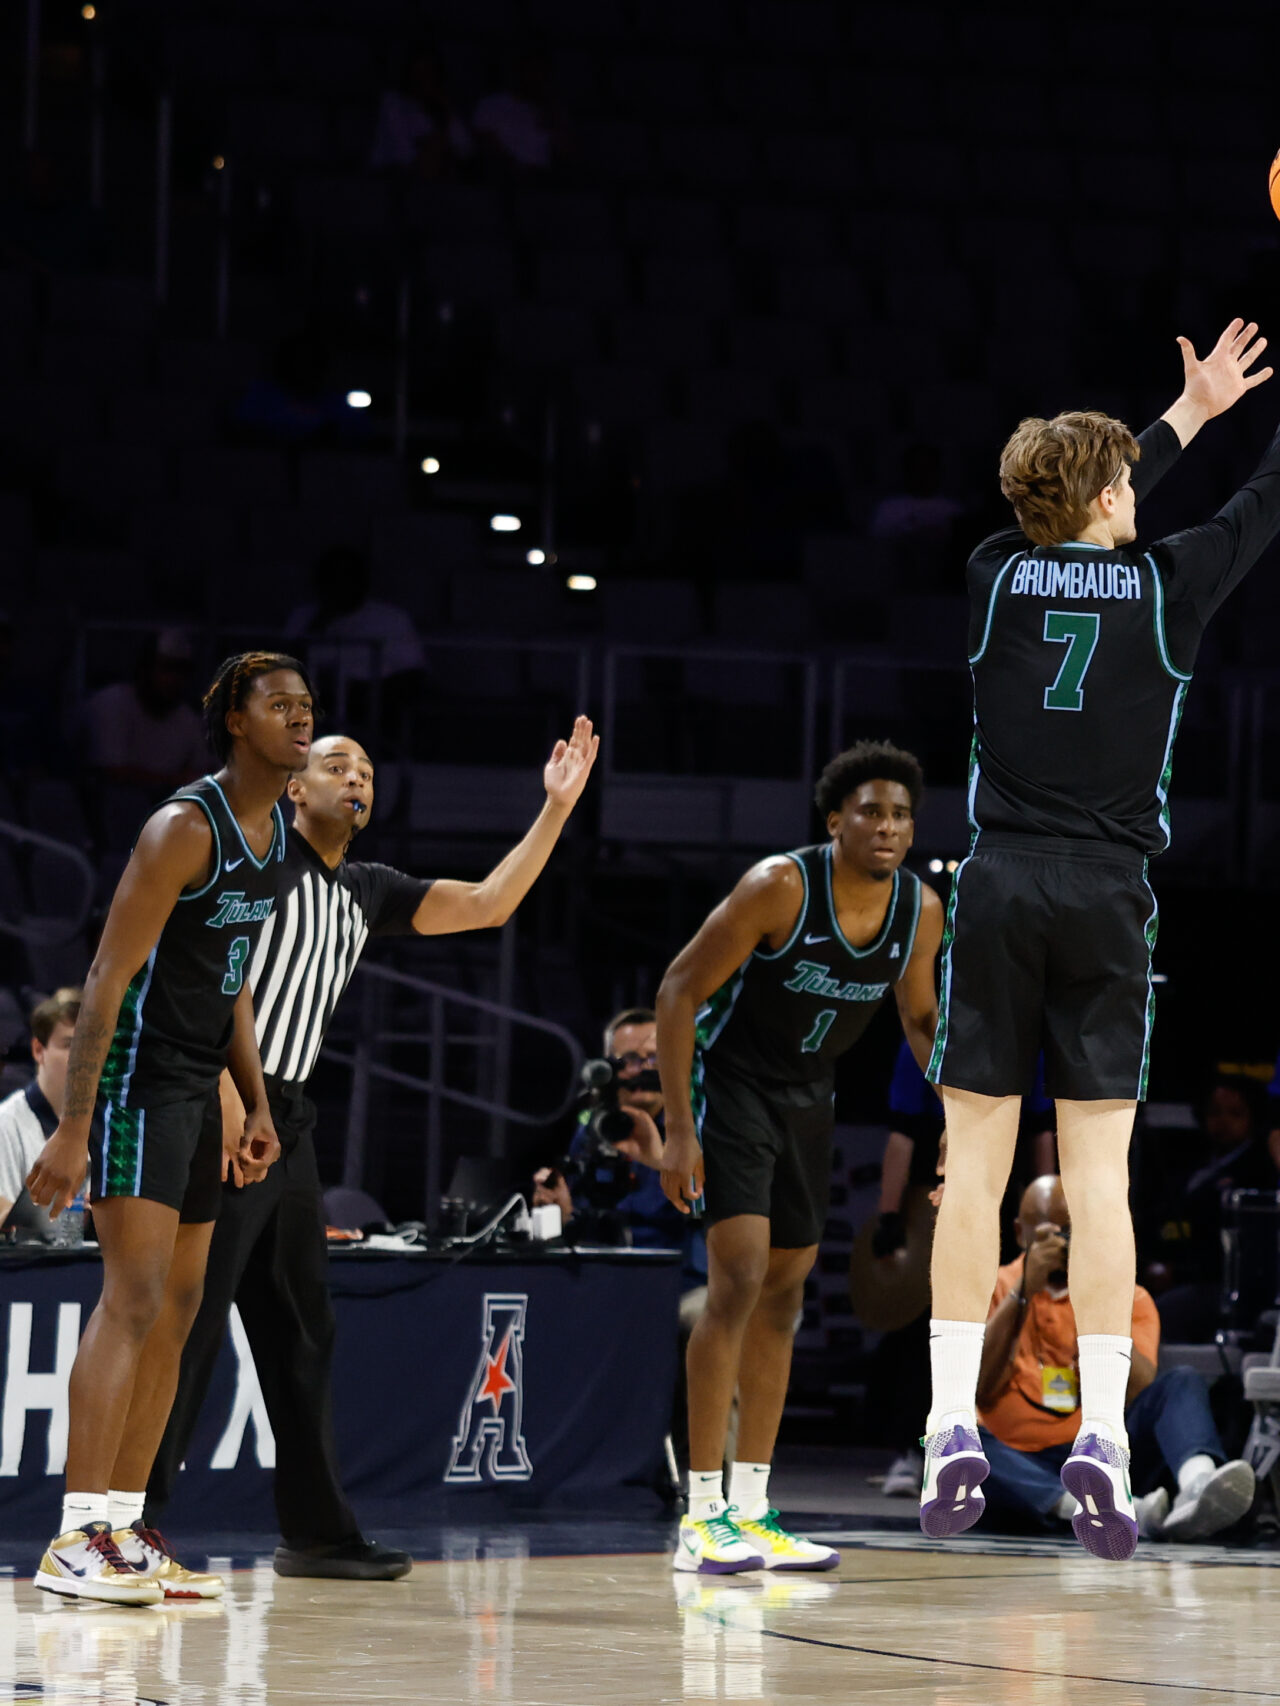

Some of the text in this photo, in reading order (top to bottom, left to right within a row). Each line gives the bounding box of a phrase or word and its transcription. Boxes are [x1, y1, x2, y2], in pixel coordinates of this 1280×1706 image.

[1010, 560, 1142, 600] BRUMBAUGH
[1043, 610, 1101, 712] 7
[221, 936, 250, 995] 3
[801, 1008, 838, 1054] 1
